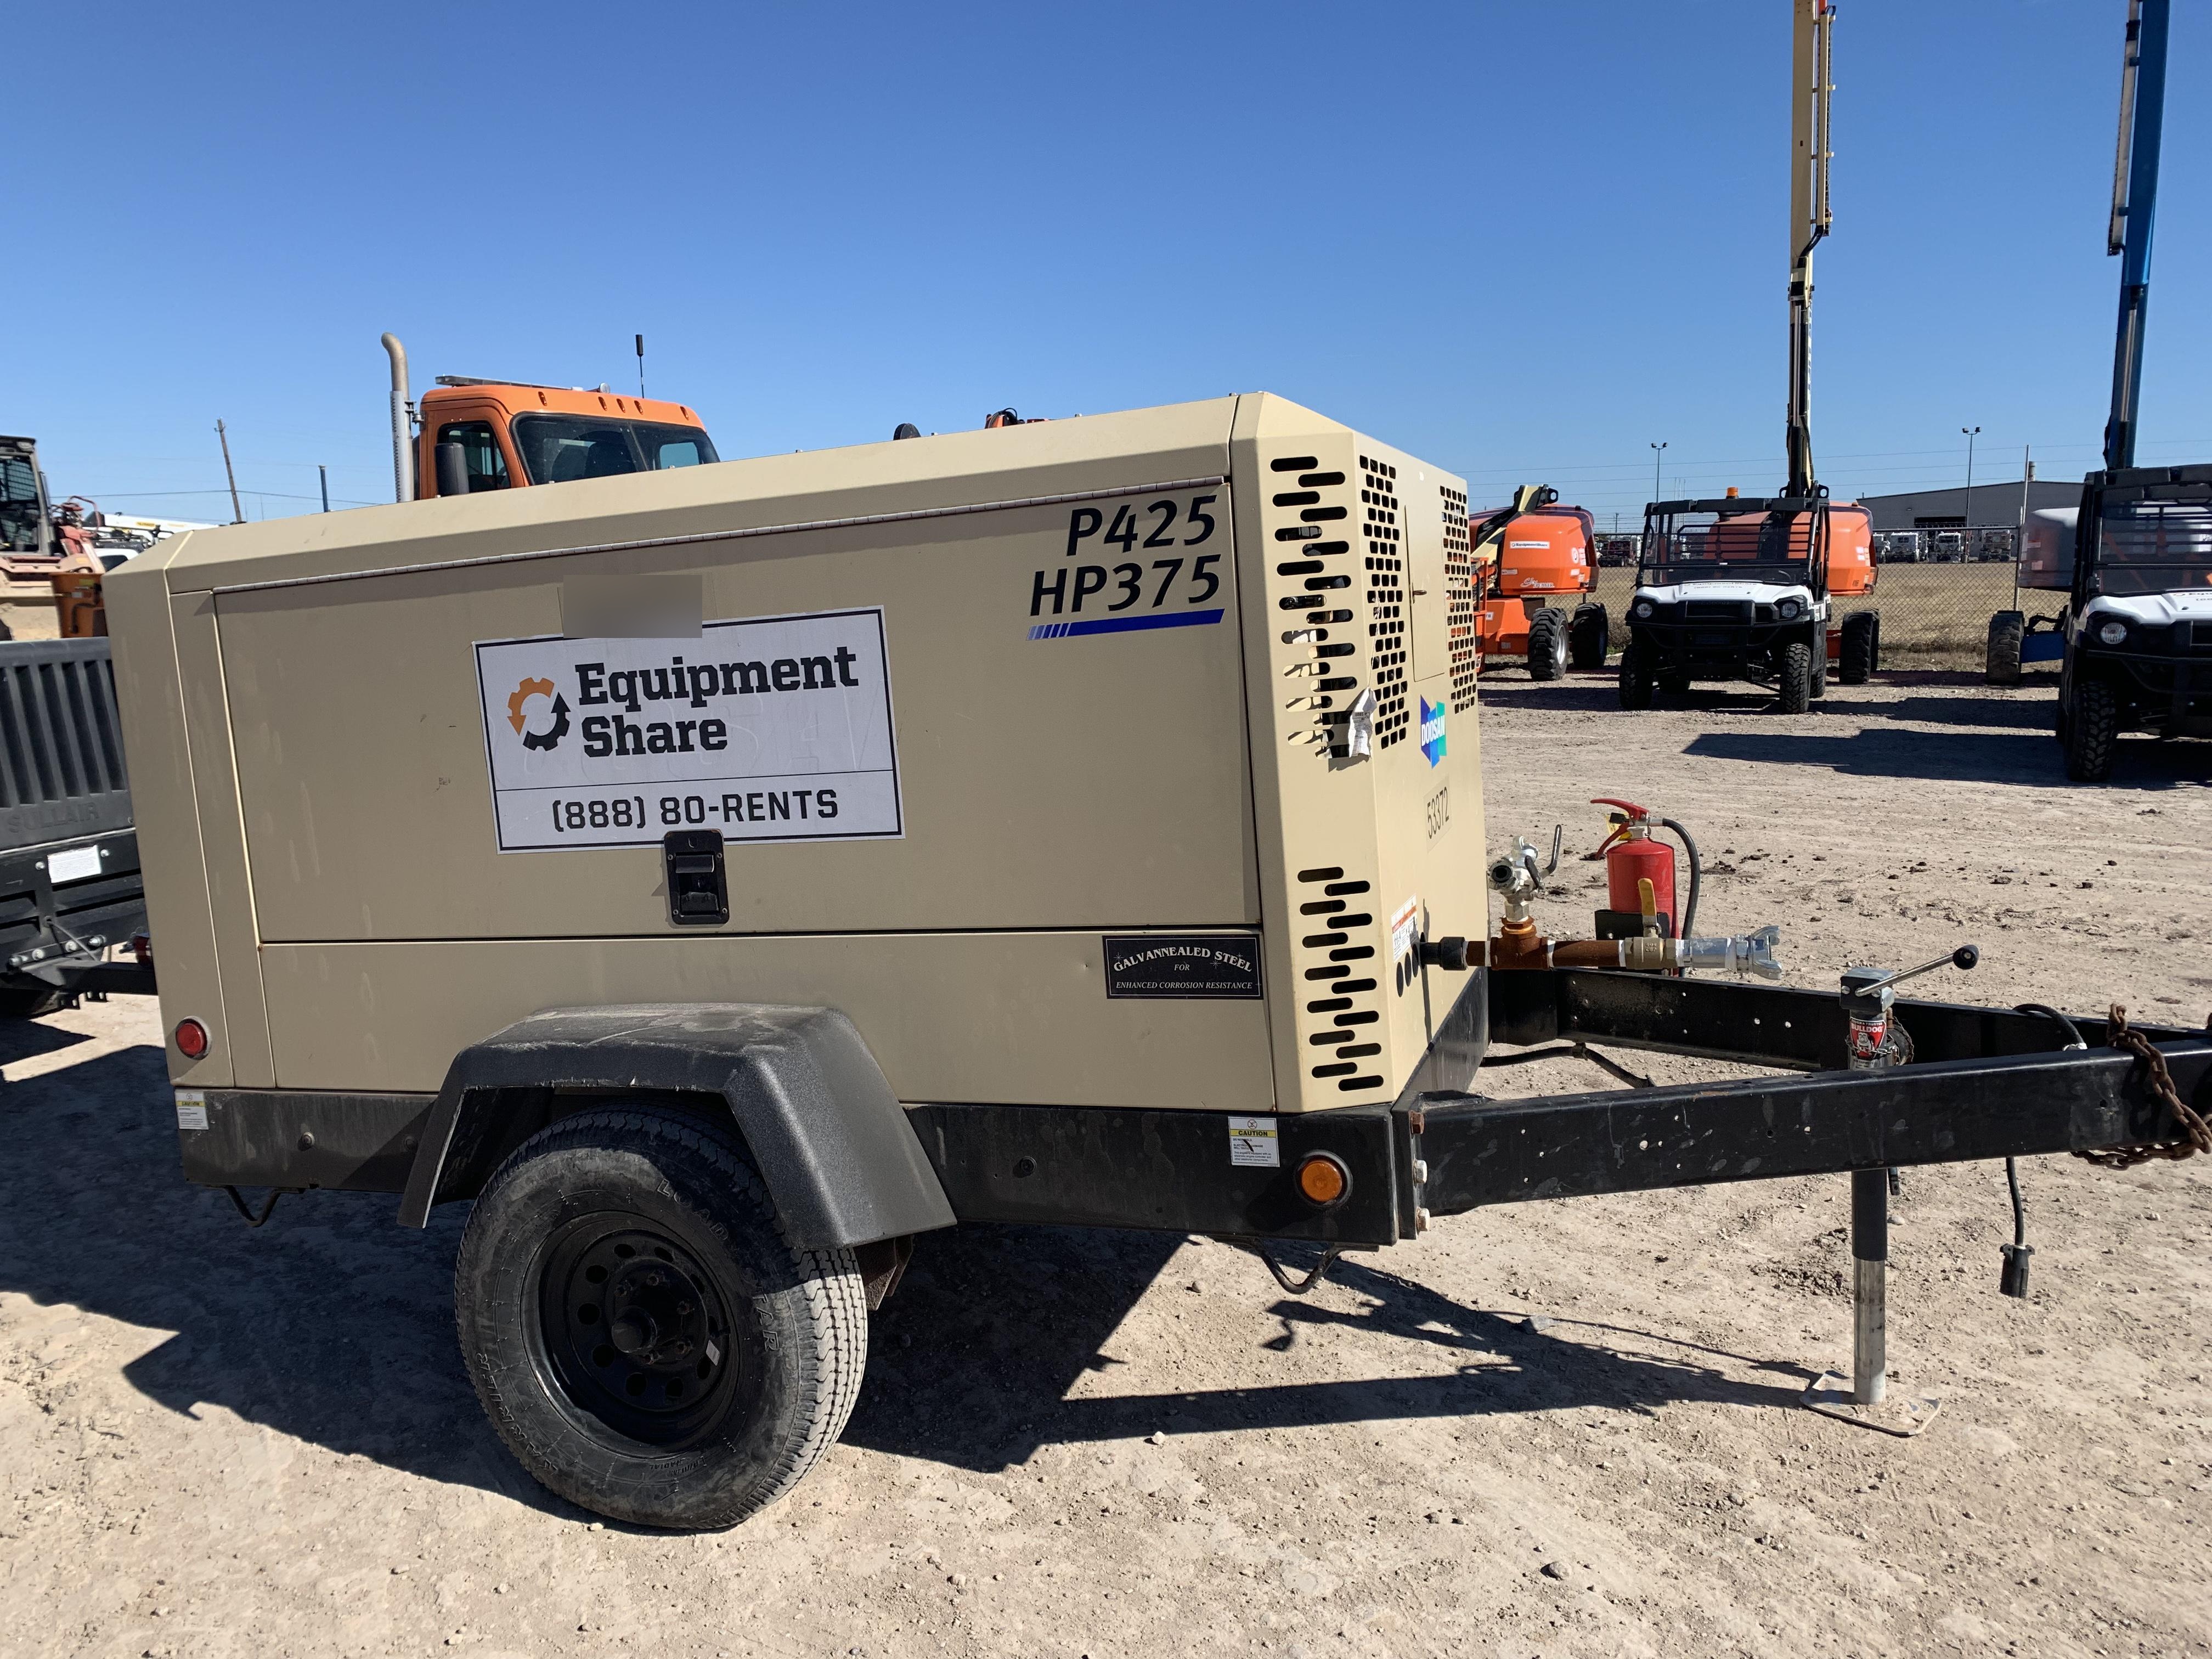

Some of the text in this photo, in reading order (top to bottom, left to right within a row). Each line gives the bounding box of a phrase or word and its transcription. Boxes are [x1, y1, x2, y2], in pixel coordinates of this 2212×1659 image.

[1066, 495, 1217, 556] P425
[1030, 554, 1221, 616] HP375
[575, 646, 859, 712] Equipment
[582, 714, 727, 758] Share
[1421, 715, 1445, 746] DOOSAN
[552, 789, 838, 832] (888) 80-RENTS
[1427, 787, 1449, 839] 53372
[1114, 946, 1252, 972] GALVANNEALED STEEL
[1852, 1023, 1883, 1032] BULLDOG
[656, 1177, 729, 1242] LOAD
